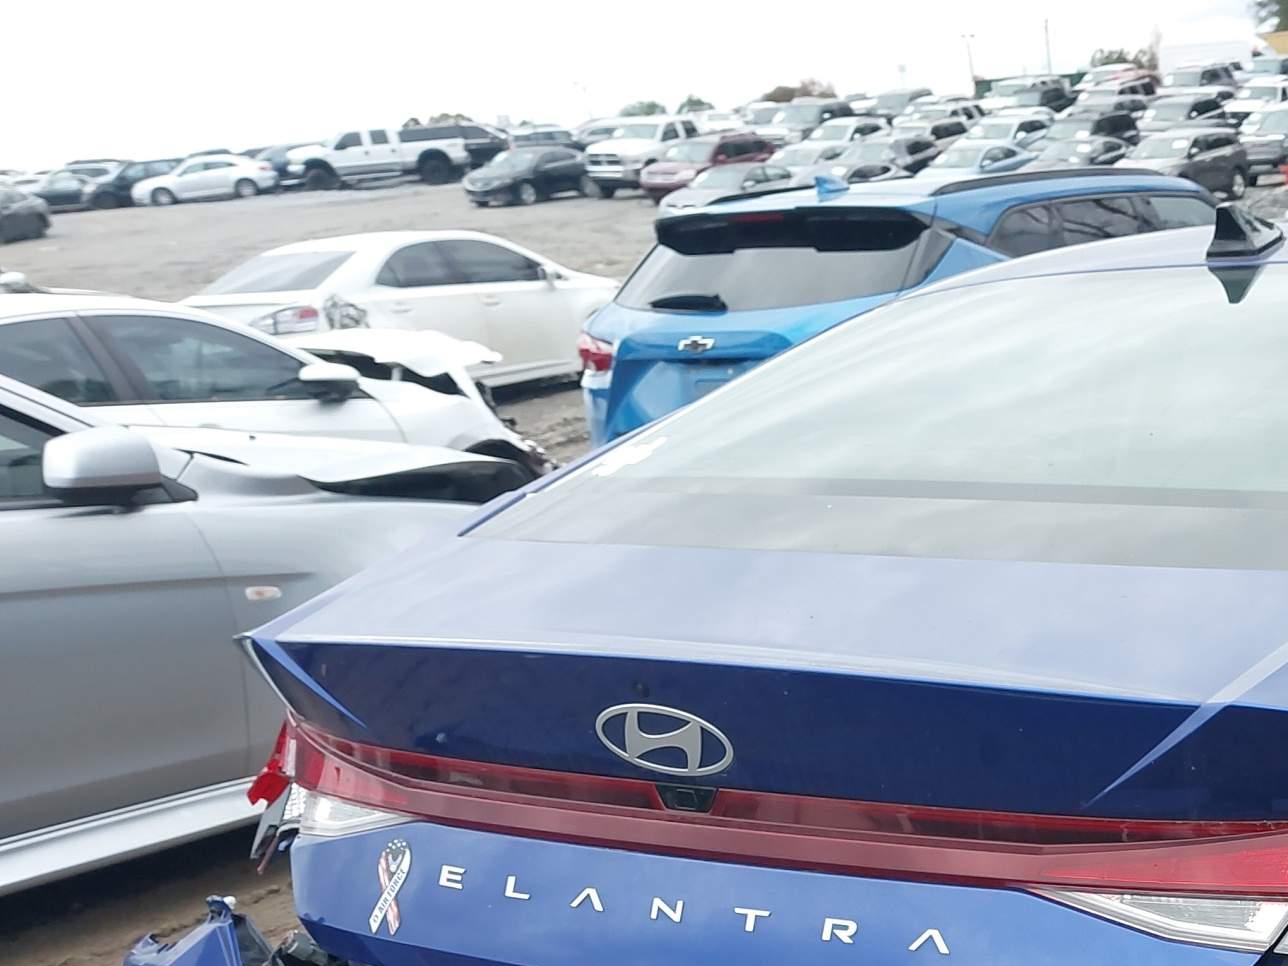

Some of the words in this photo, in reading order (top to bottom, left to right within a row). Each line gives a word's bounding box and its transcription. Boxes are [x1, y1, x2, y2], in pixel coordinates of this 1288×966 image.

[378, 897, 390, 914] AIR
[387, 869, 406, 897] FORCE
[438, 864, 951, 954] ELANTRA
